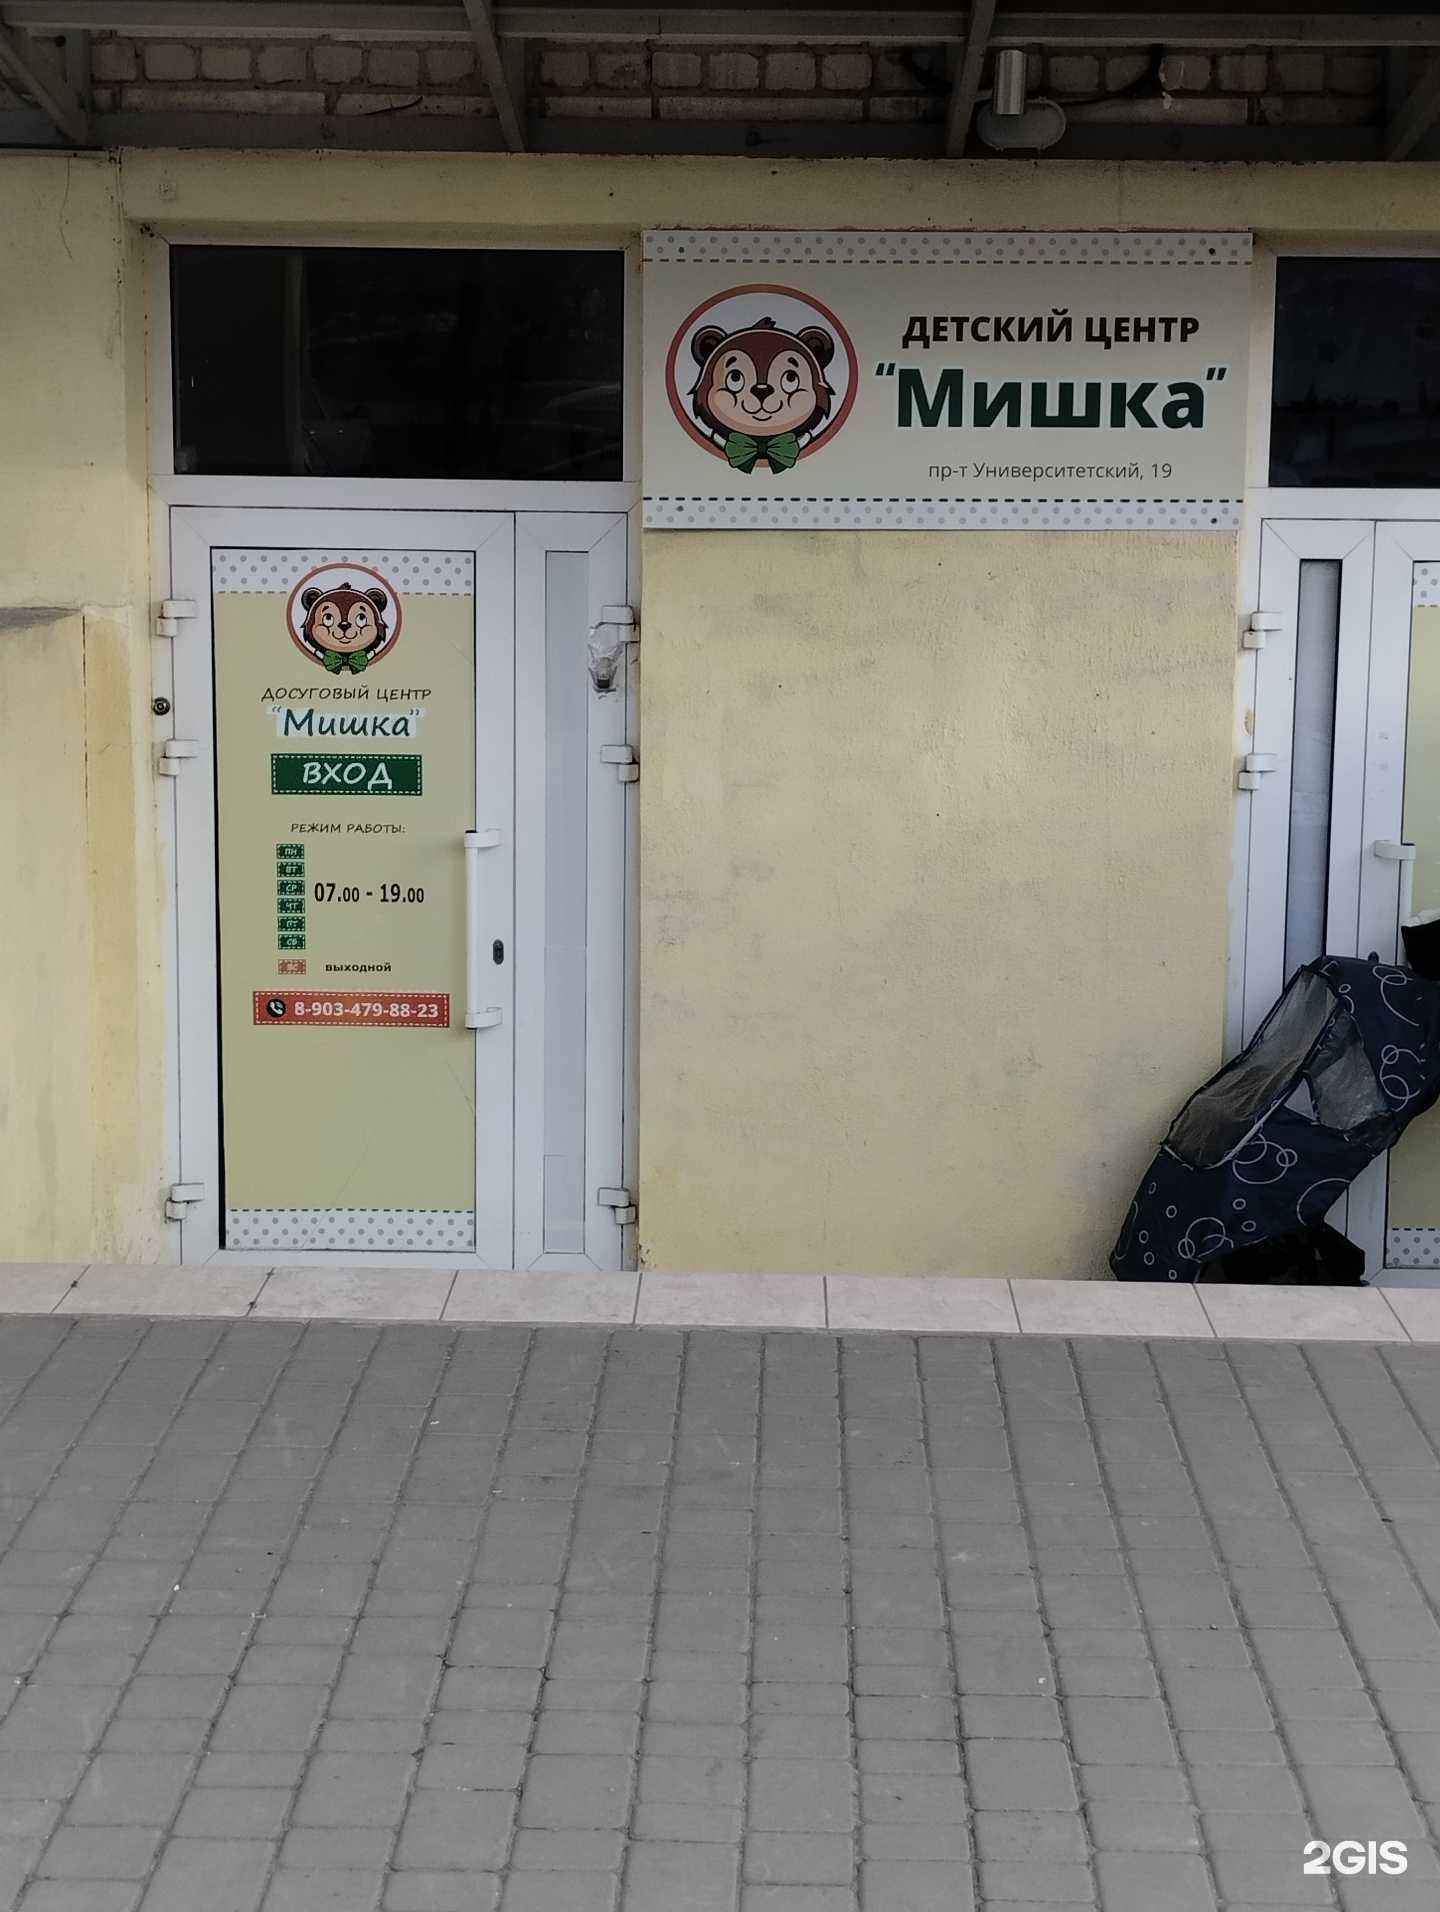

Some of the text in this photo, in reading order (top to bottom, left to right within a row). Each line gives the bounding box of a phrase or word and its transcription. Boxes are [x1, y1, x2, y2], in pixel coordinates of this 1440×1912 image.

[902, 308, 1200, 349] ДЕТСКИЙ ЦЕНТР
[928, 462, 1173, 482] пр-т Университетский, 19
[260, 684, 432, 703] ДОСУГОВЫЙ ЦЕНТР
[302, 762, 393, 791] ВХОД
[290, 823, 406, 834] РЕЖИМ РАБОТЫ:
[314, 883, 360, 903] 07.00
[380, 884, 425, 903] 19.00
[294, 1001, 439, 1018] 8-903-479-88-23
